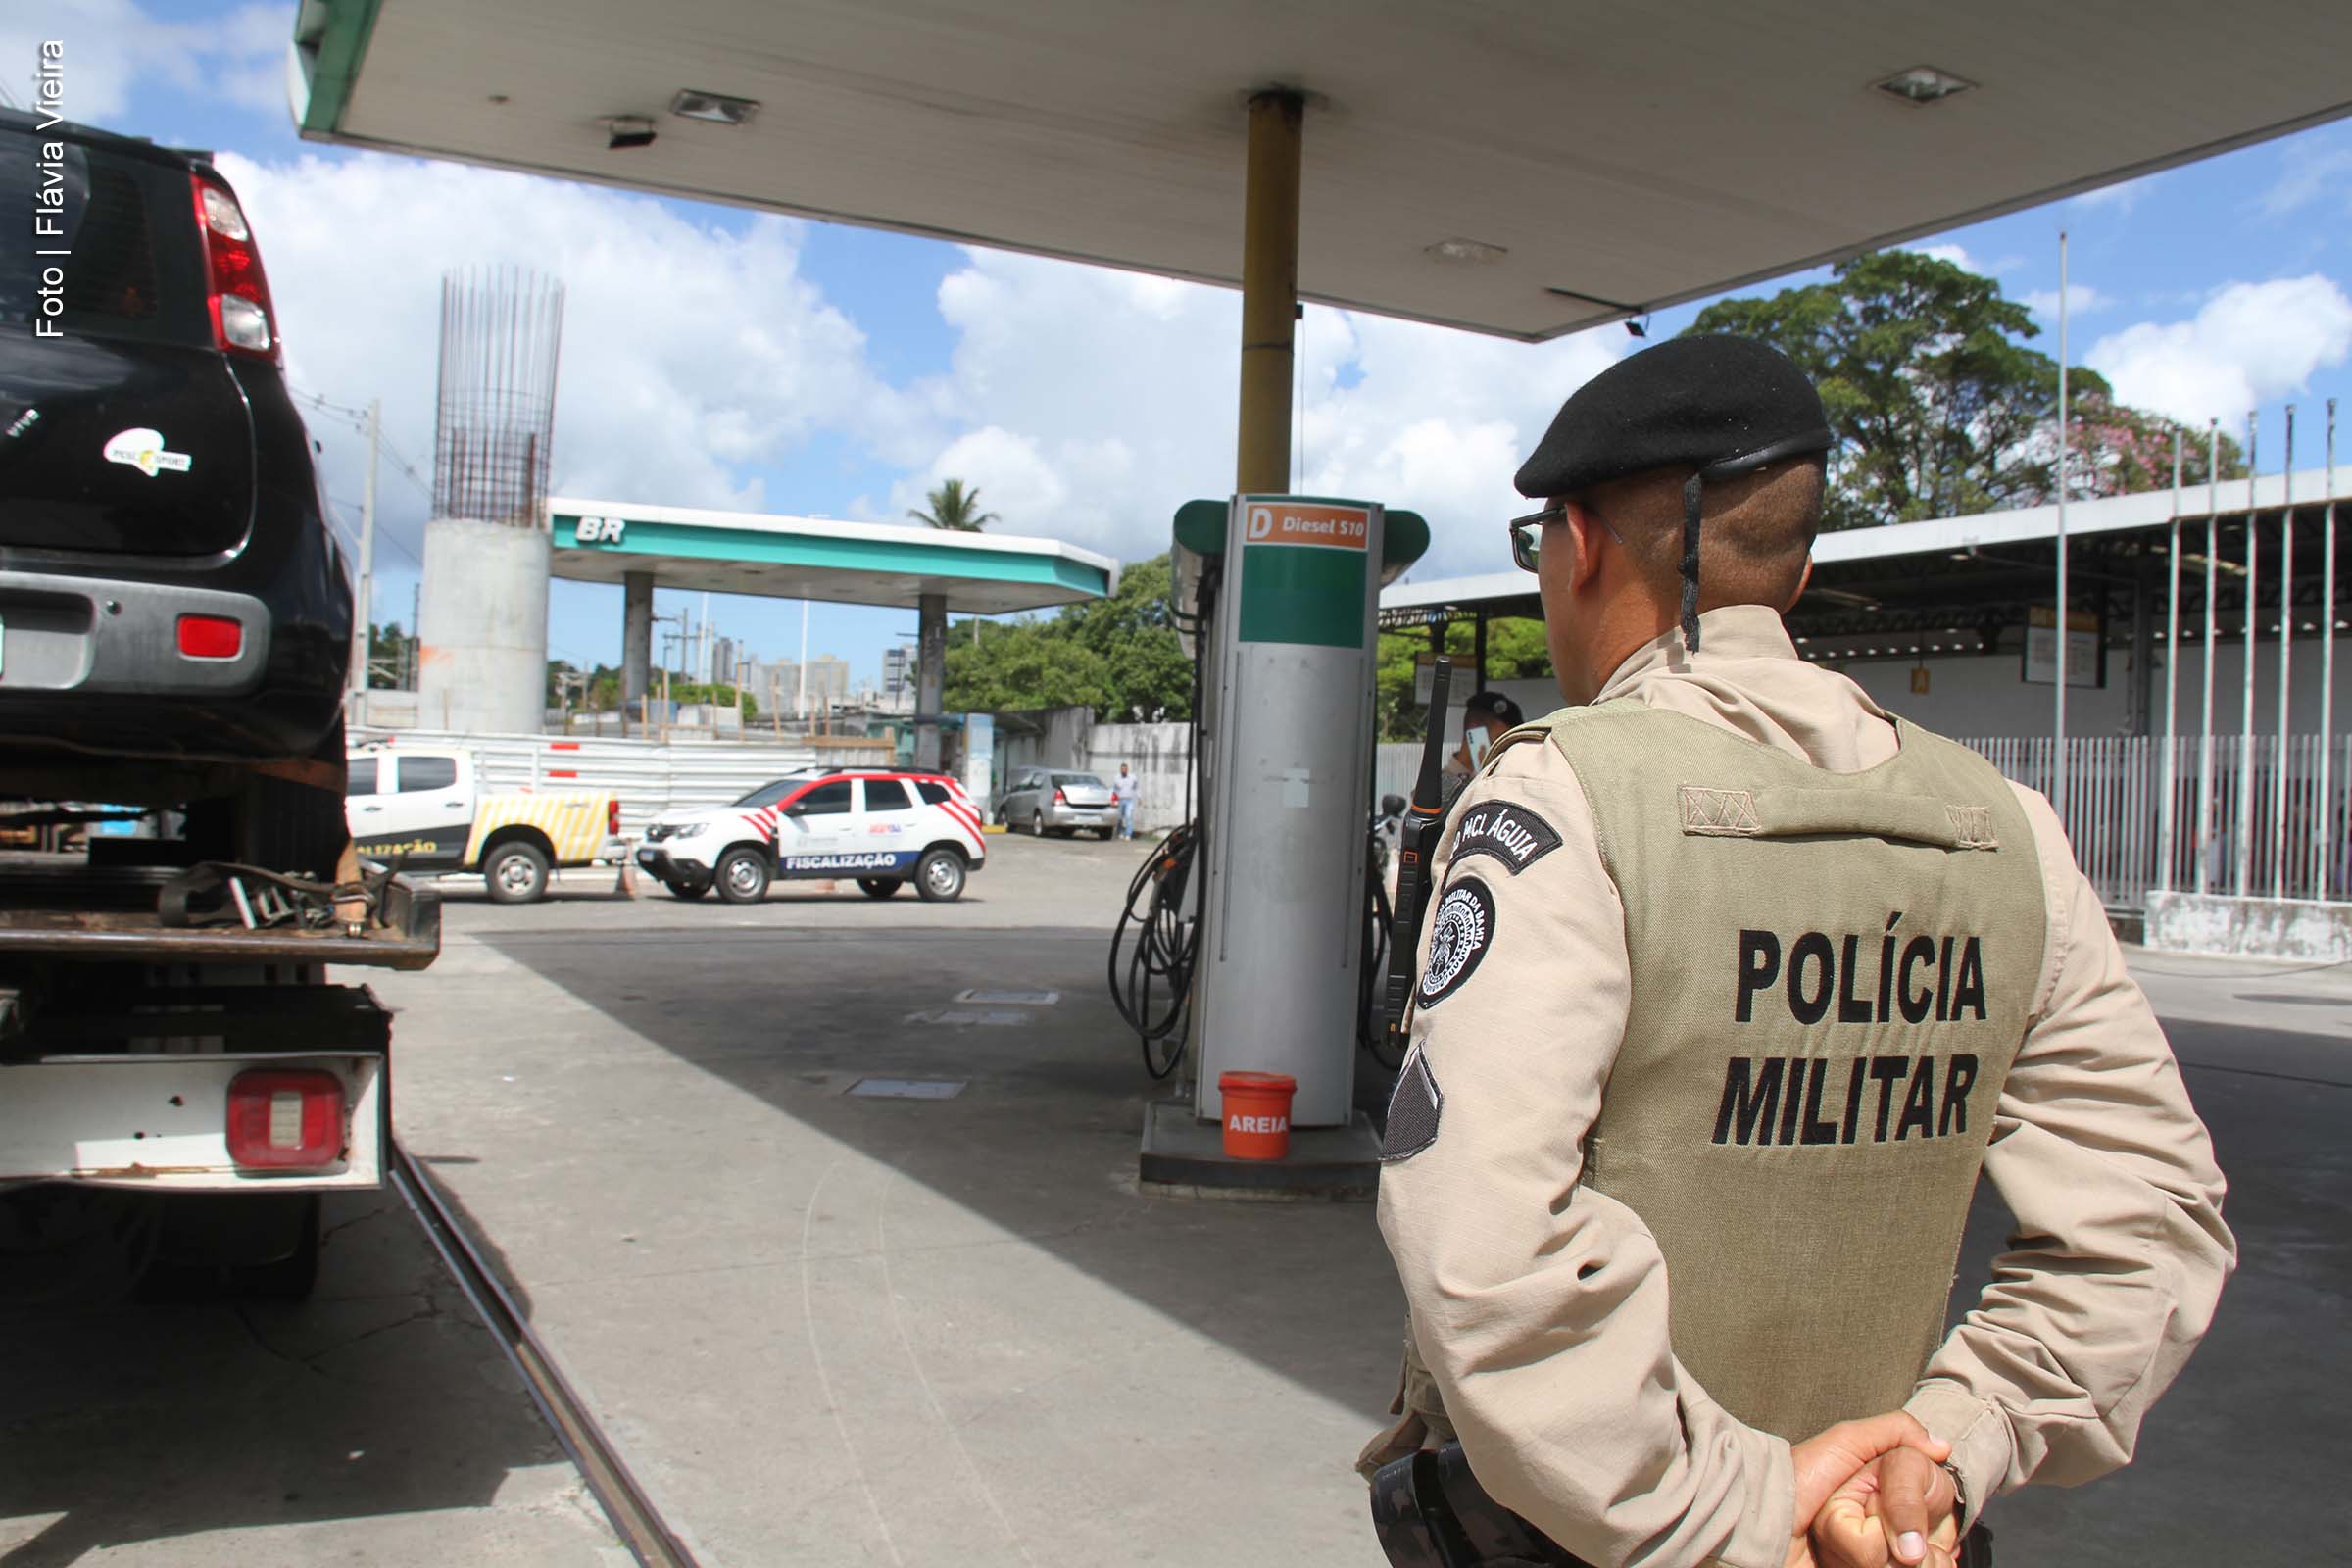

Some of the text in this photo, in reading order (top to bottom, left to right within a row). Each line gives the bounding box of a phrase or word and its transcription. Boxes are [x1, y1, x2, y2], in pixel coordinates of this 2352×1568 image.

[575, 516, 625, 543] BR
[1250, 508, 1364, 539] D Diesel S10
[1486, 808, 1538, 862] ÁGUIA
[786, 851, 896, 870] FISCALIZAÇÃO
[1471, 909, 1485, 950] BAHIA
[1735, 911, 1987, 1025] POLÍCIA
[1711, 1054, 1979, 1146] MILITAR
[1229, 1113, 1287, 1133] AREIA
